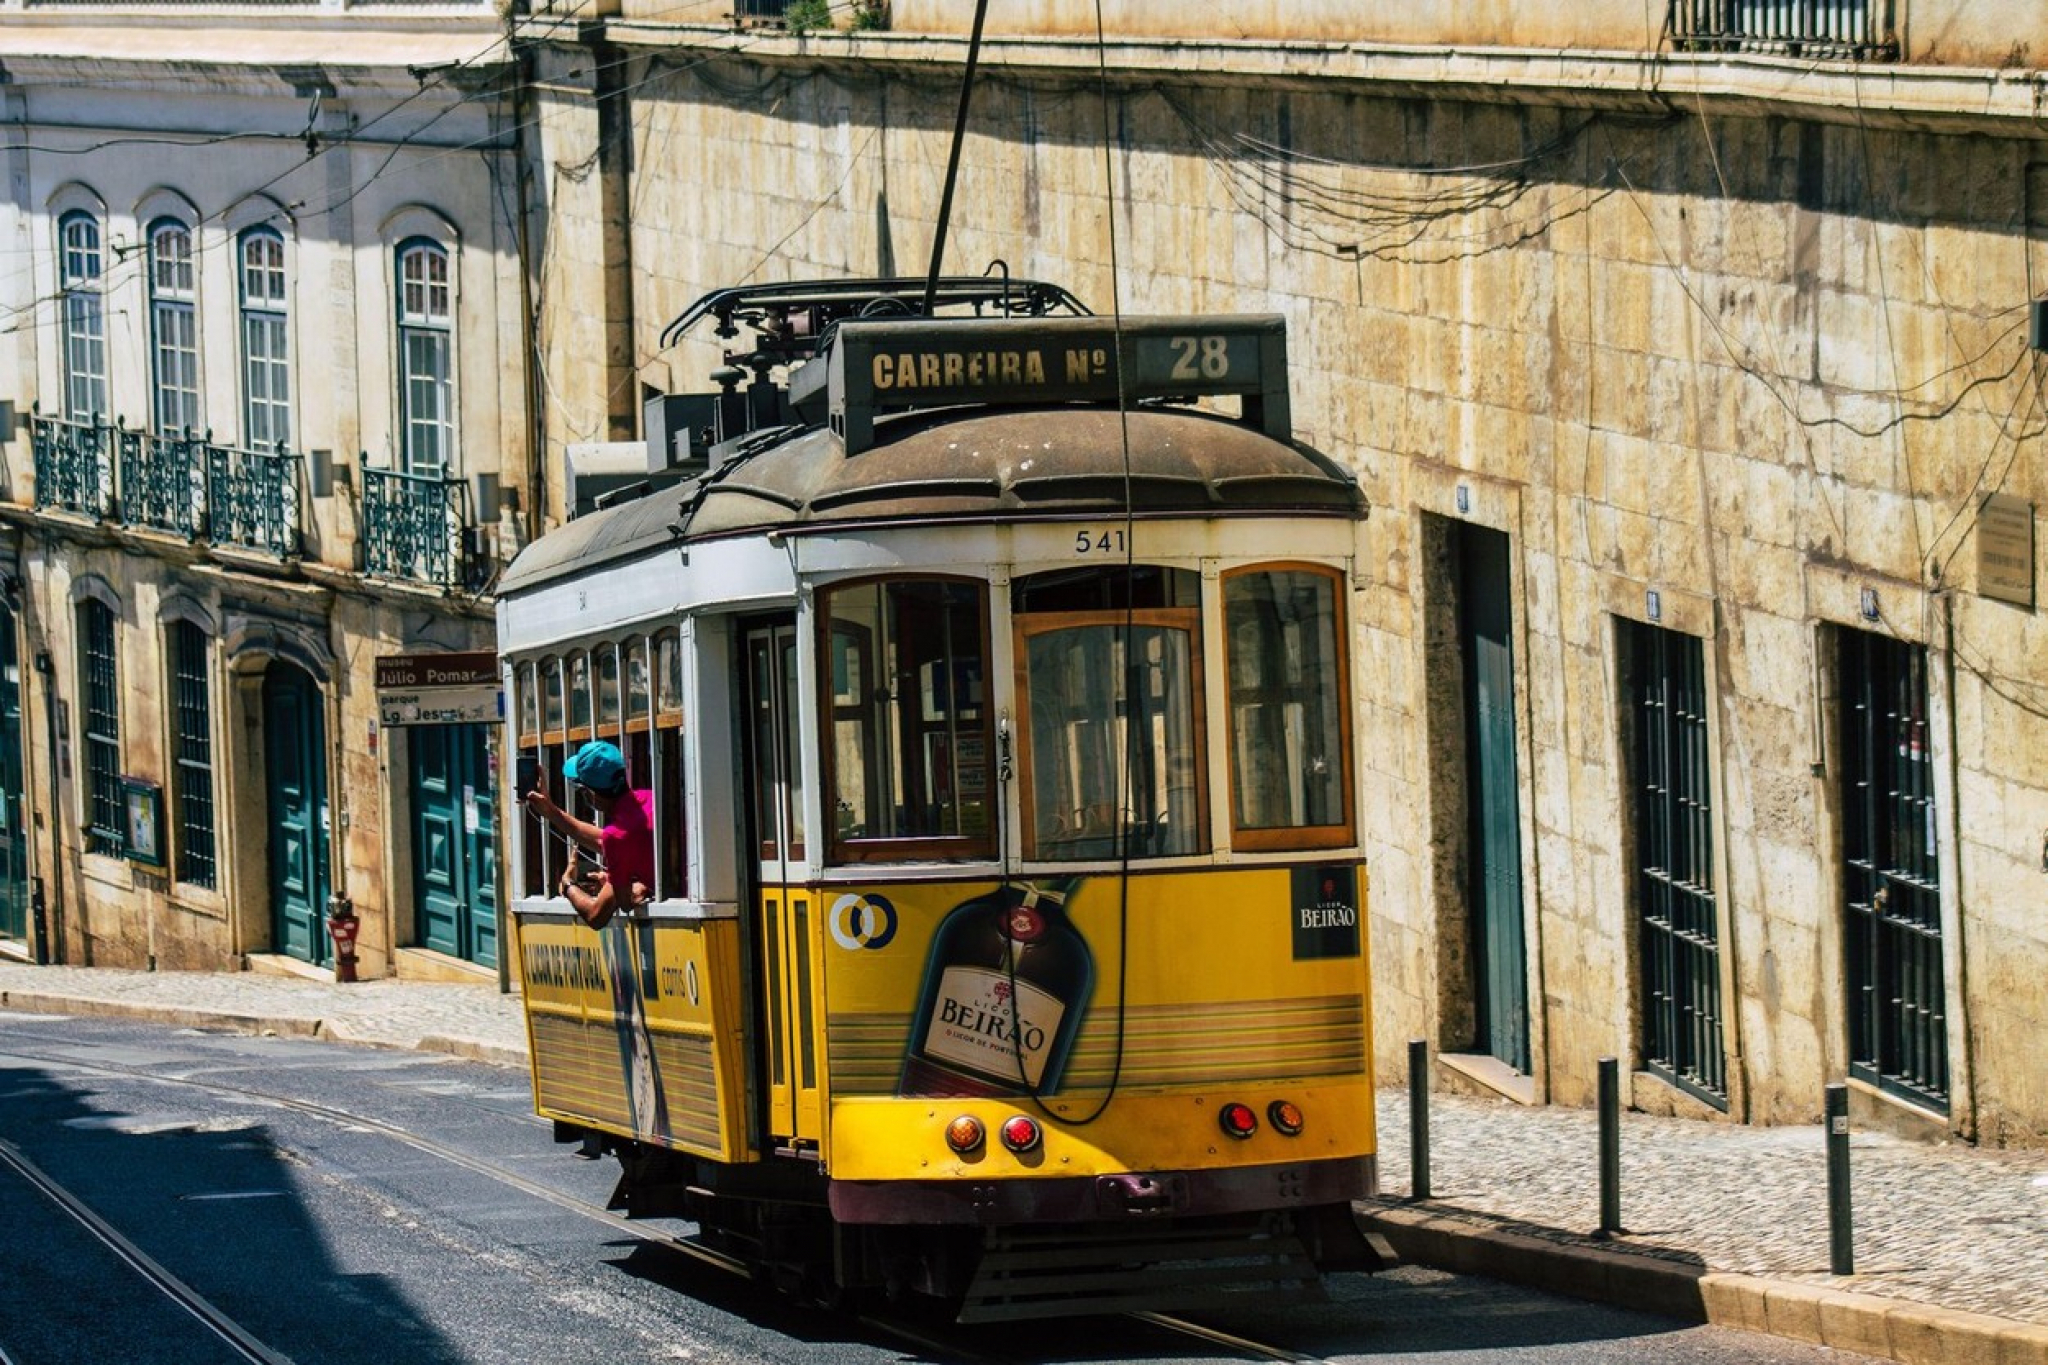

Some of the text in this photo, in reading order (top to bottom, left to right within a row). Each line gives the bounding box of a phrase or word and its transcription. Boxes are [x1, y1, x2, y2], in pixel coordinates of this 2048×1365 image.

[872, 350, 1045, 389] CARREIRA
[1169, 335, 1230, 381] 28
[1075, 530, 1125, 553] 541
[378, 658, 414, 668] museu
[379, 671, 417, 686] Júlio
[426, 669, 478, 683] Pomar
[381, 695, 420, 706] parque
[1300, 905, 1356, 929] BEIRÃO
